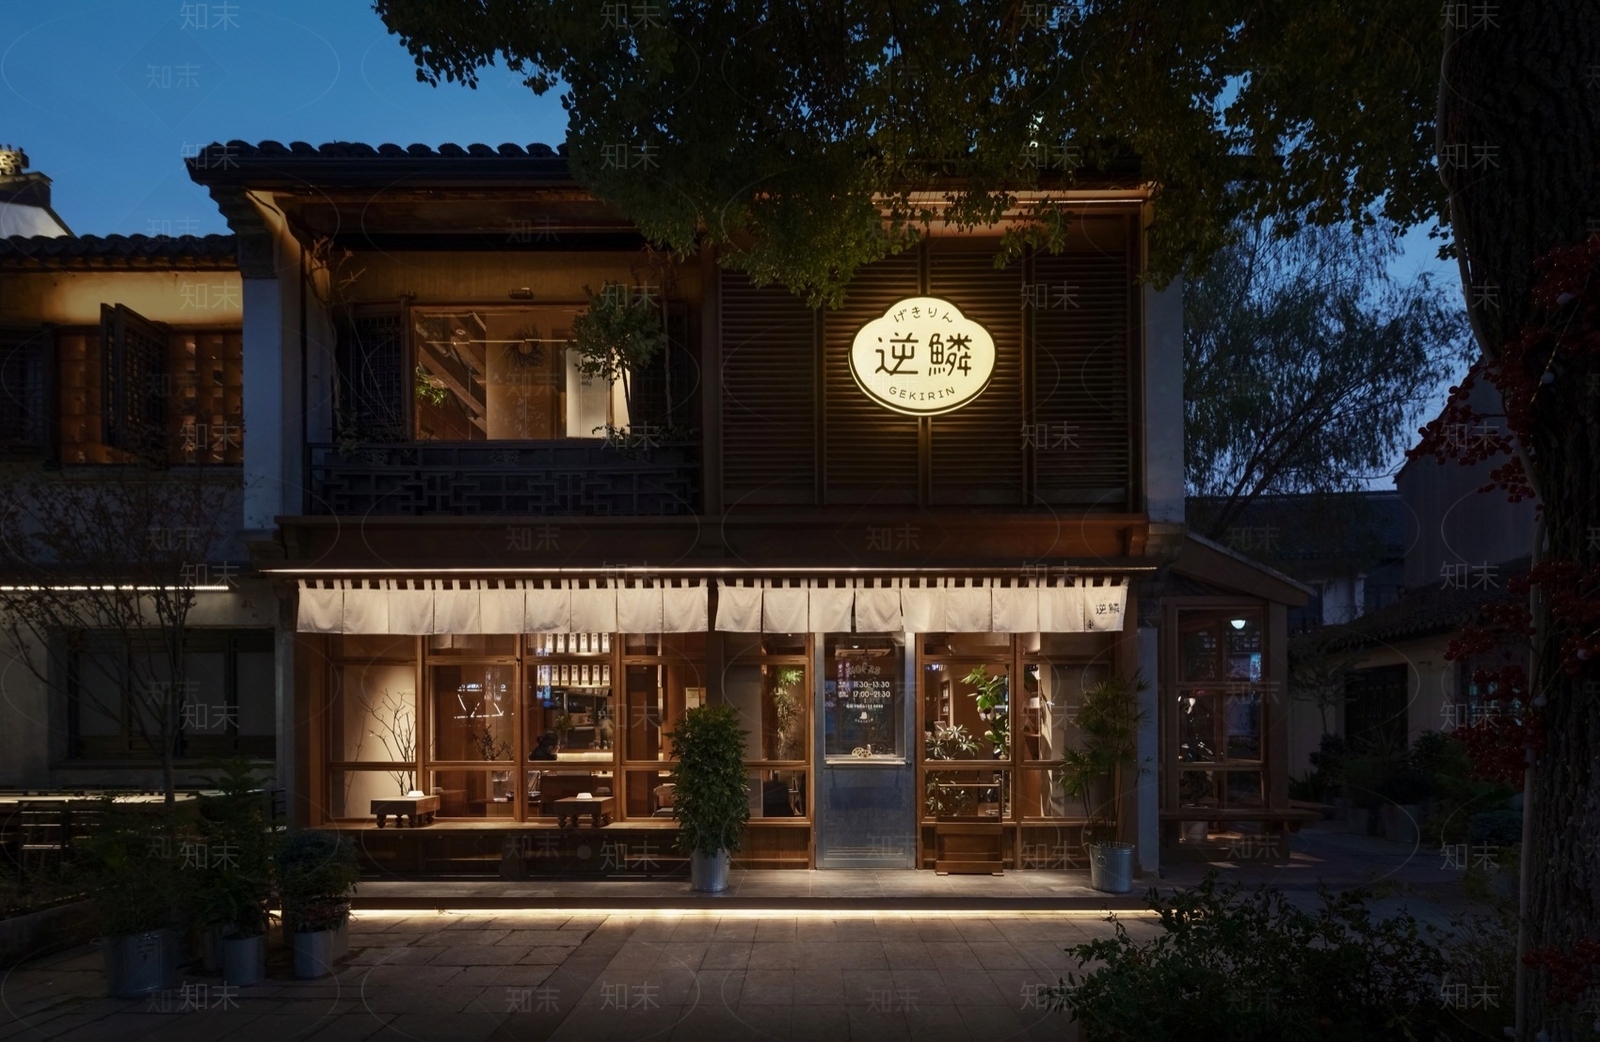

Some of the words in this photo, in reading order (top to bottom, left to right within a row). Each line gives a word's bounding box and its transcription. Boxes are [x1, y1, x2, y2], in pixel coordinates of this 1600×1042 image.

[894, 306, 953, 323] げきりん
[875, 332, 973, 376] 逆鱗
[889, 386, 955, 401] GEKIRIN
